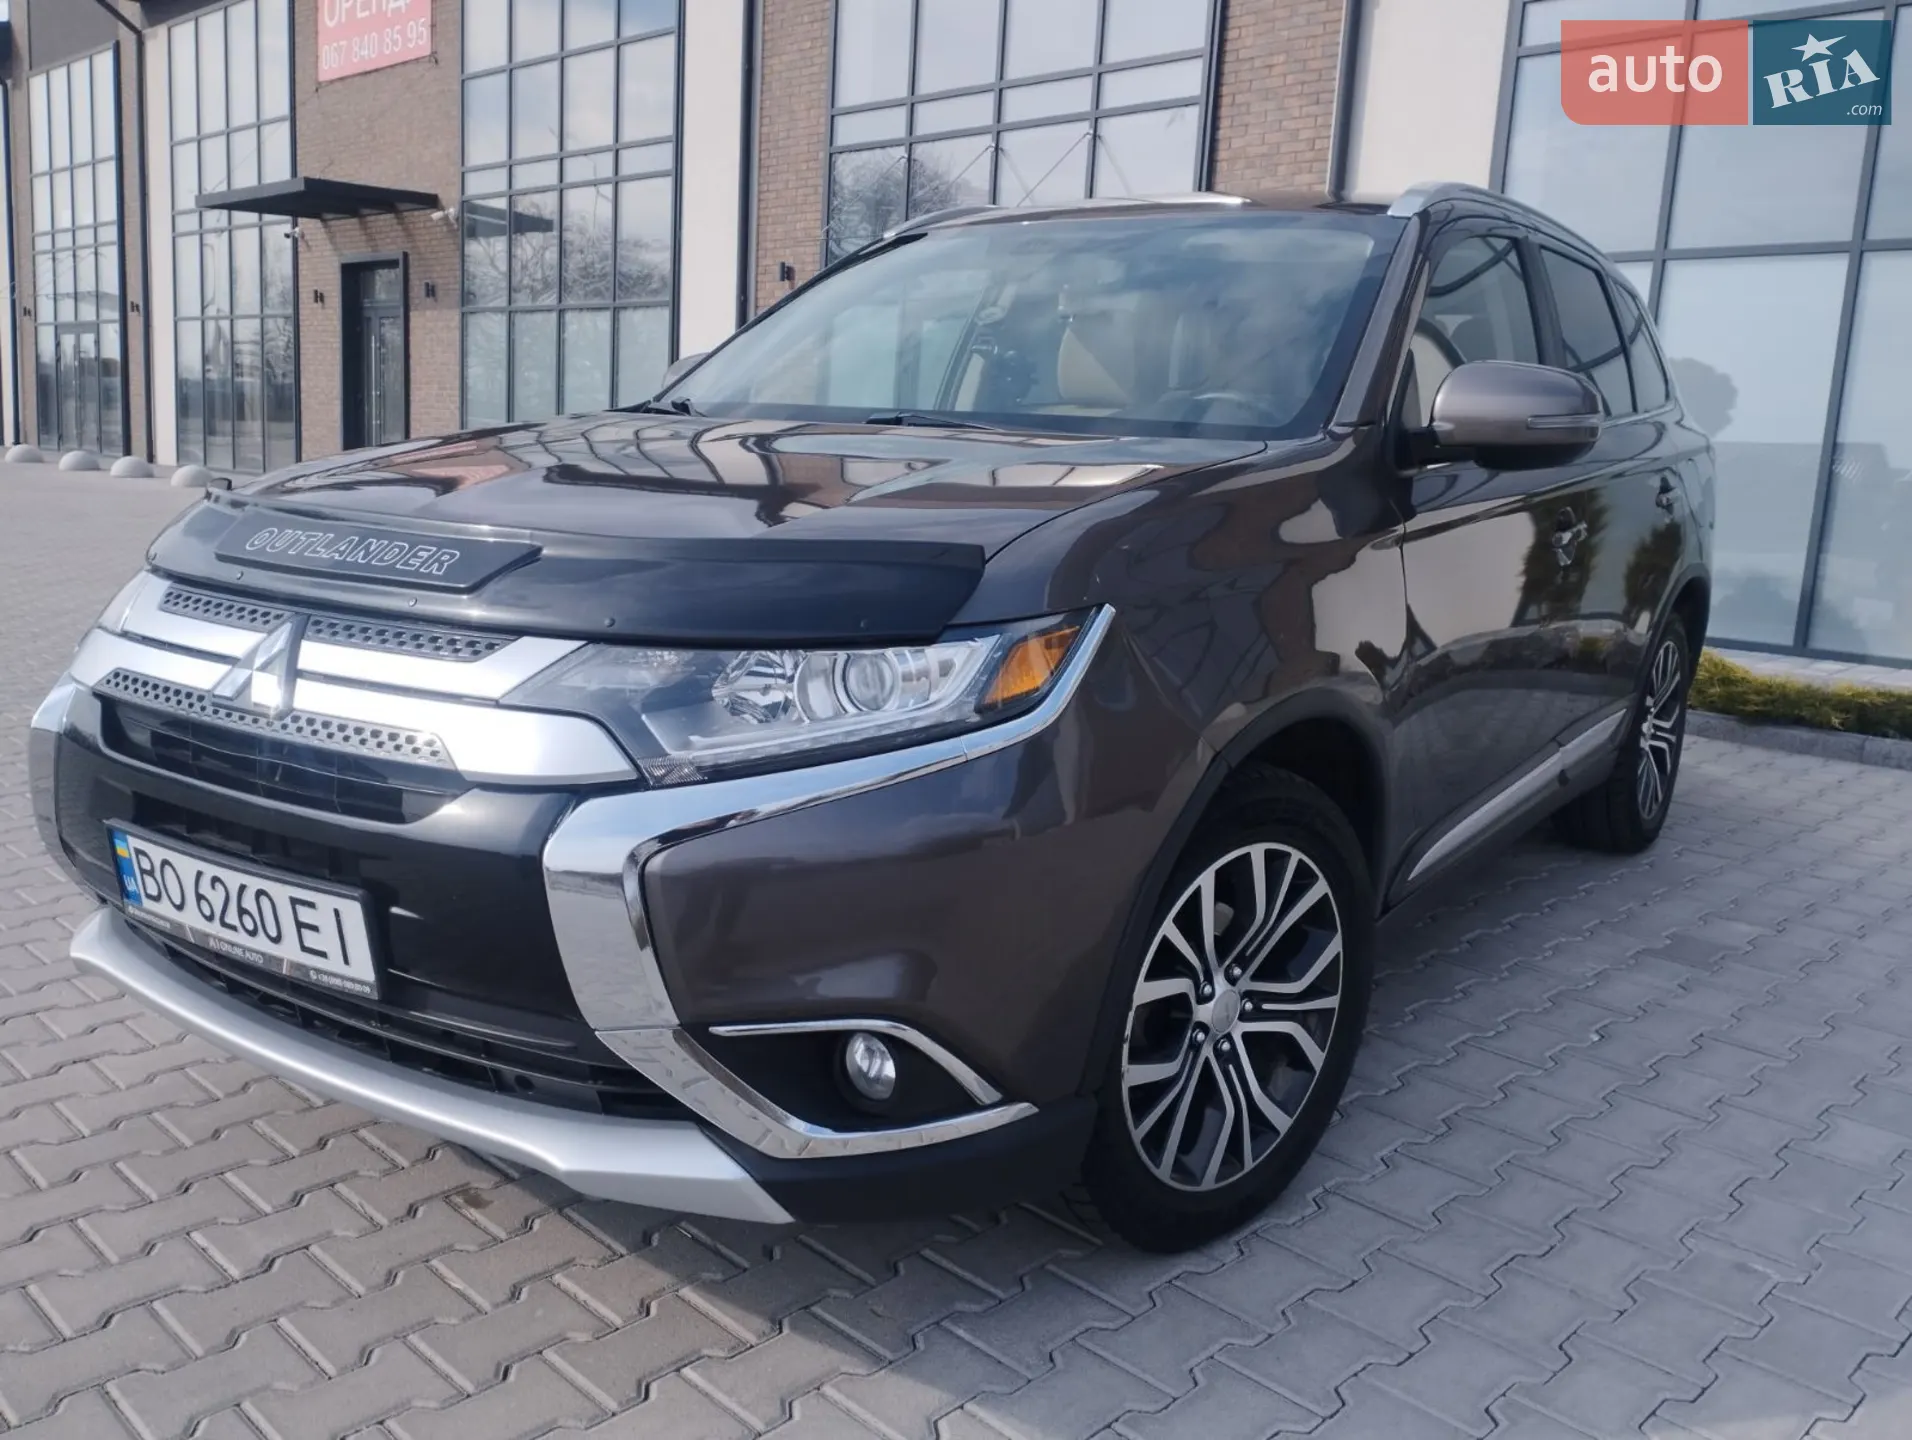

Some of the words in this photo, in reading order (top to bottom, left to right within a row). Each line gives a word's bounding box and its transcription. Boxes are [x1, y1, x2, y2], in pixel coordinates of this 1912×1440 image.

[324, 0, 411, 28] ОРЕД
[321, 40, 347, 70] 067
[352, 31, 379, 63] 840
[383, 24, 402, 55] 85
[406, 17, 427, 49] 95
[245, 527, 460, 575] OUTLANDER
[133, 846, 186, 912] BO
[194, 869, 283, 945] 6260
[288, 895, 351, 967] EI
